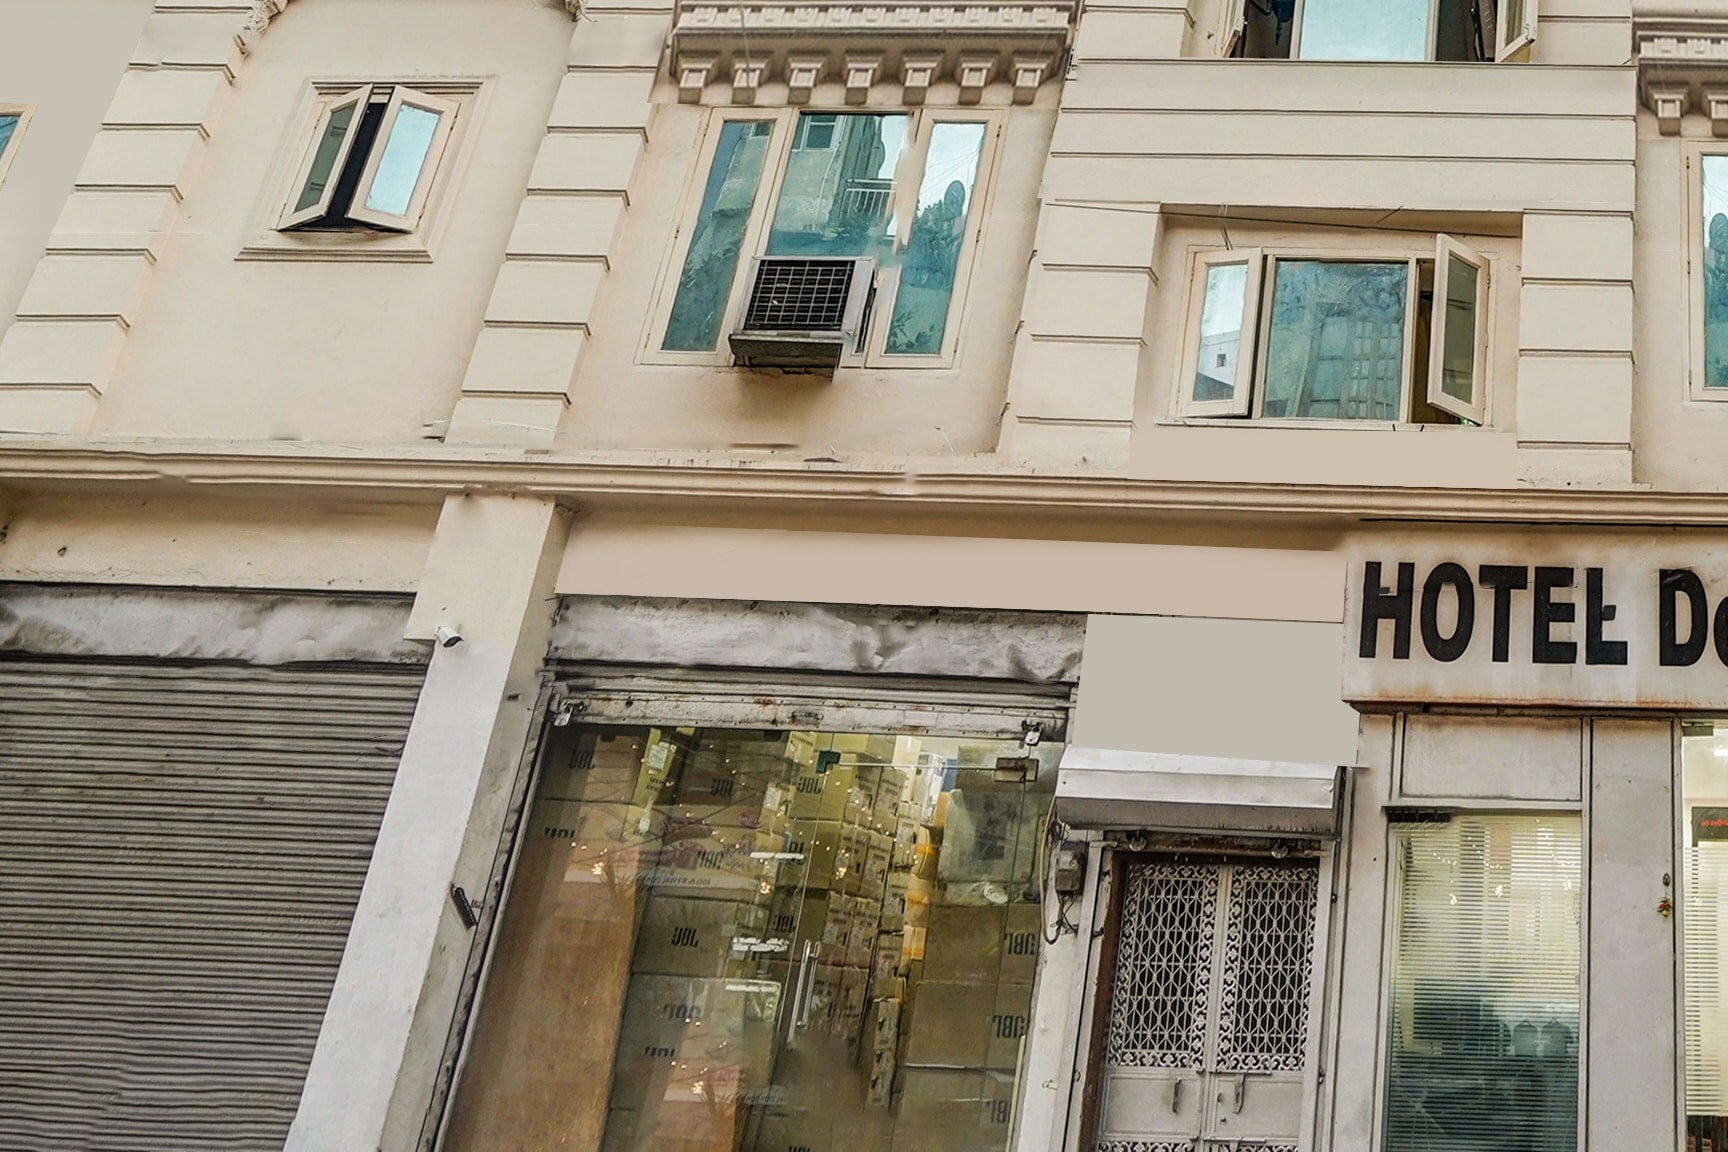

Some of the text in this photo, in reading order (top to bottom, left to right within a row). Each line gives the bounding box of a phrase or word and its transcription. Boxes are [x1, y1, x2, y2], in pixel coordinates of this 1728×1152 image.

[797, 777, 822, 794] JBL
[671, 927, 699, 947] JBL
[1003, 932, 1035, 955] JBL
[992, 1015, 1027, 1039] JBL
